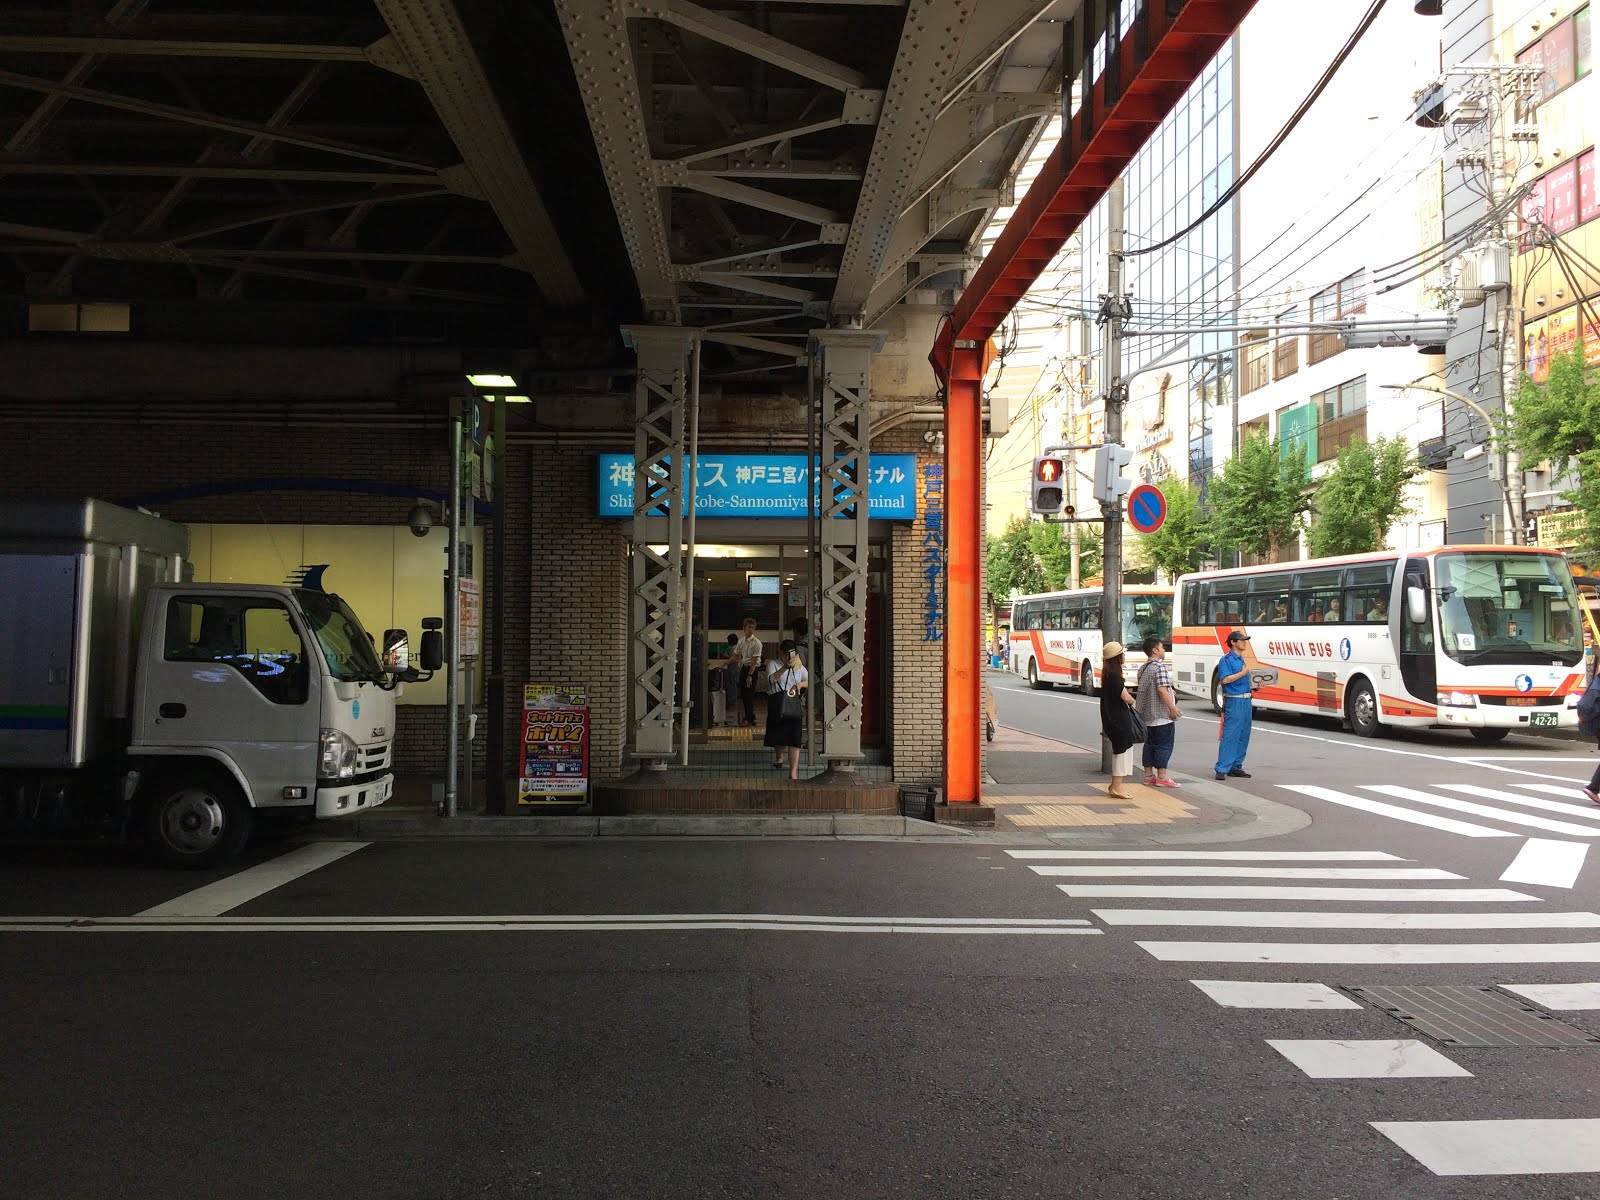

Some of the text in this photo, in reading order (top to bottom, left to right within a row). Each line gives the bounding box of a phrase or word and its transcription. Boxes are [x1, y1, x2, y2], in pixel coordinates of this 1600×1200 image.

[609, 461, 906, 489] 神ス 神戸三宮バナル
[840, 494, 905, 509] Tminal
[923, 463, 943, 642] 神戸三宮バスターミナル
[1268, 641, 1333, 657] SHINKI BUS
[1462, 637, 1471, 647] 6
[528, 712, 583, 723] ネットカフェ
[526, 725, 584, 742] ポパイ
